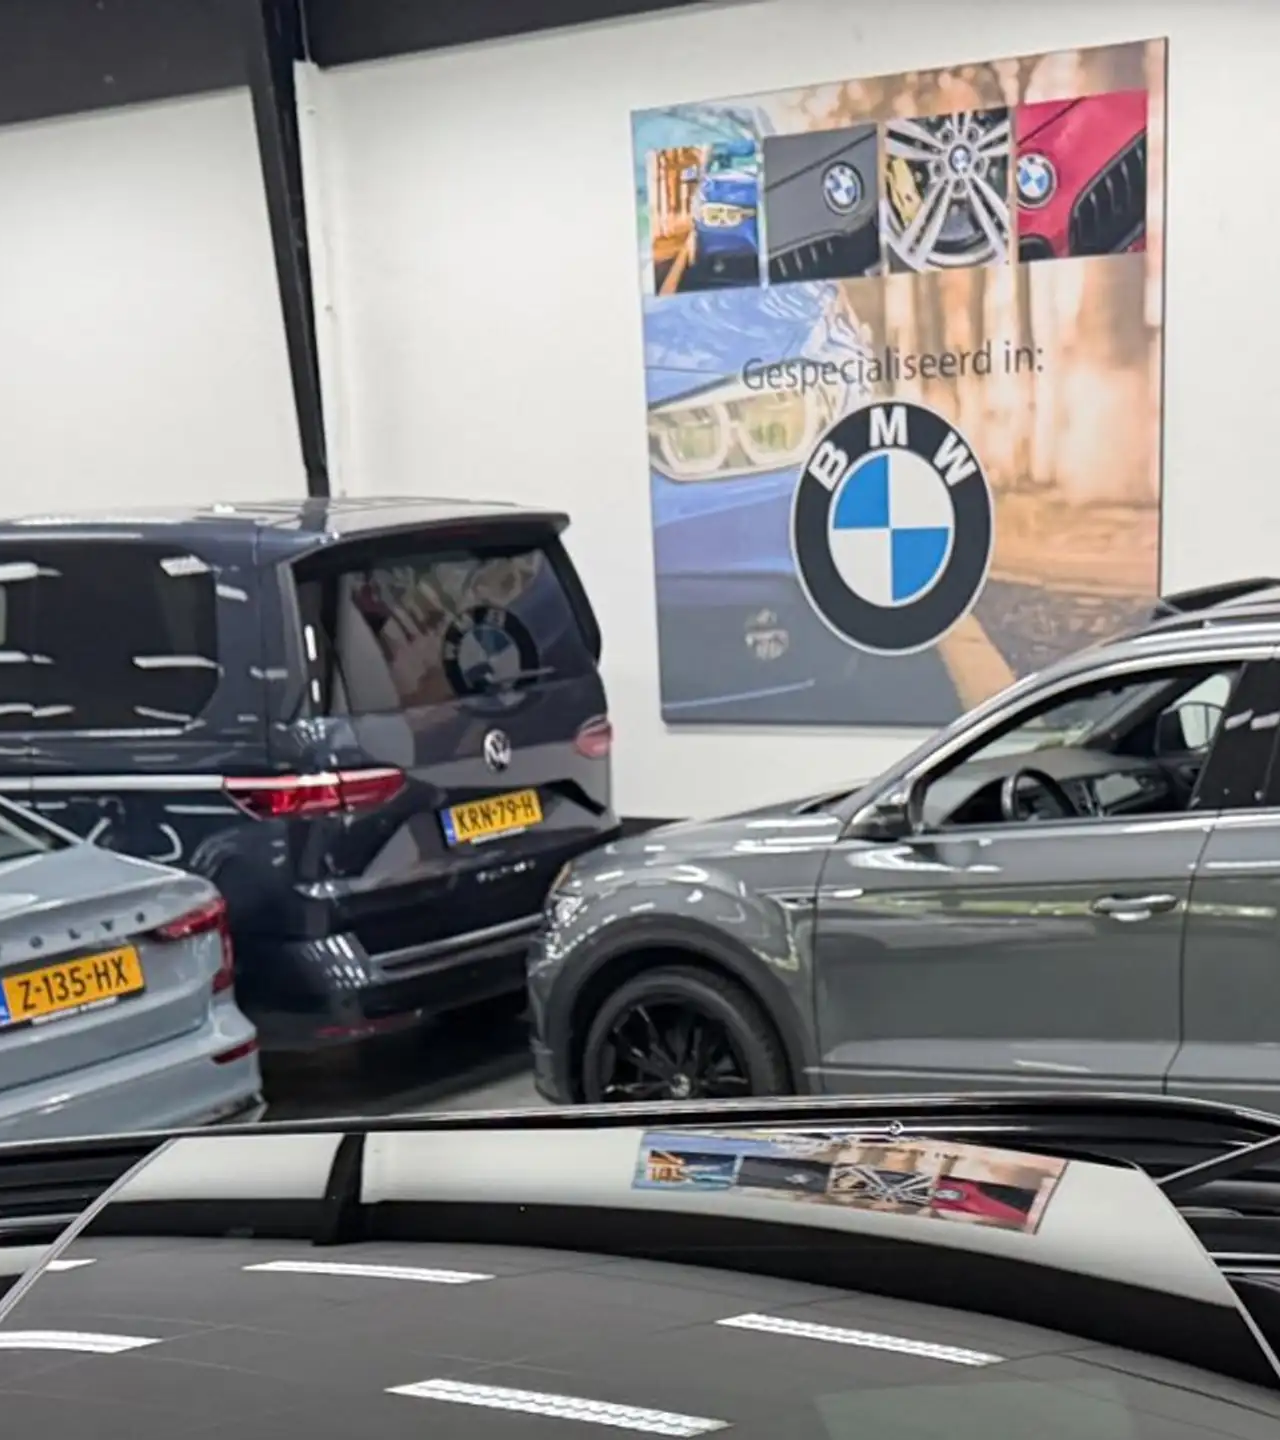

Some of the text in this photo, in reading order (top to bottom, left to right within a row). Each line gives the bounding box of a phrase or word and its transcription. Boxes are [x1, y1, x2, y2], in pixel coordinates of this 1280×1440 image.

[742, 341, 1045, 394] Gespecialiseerd in:
[808, 405, 978, 491] BMW
[455, 792, 537, 835] KRN-79-H
[18, 956, 130, 1012] Z-135-HX
